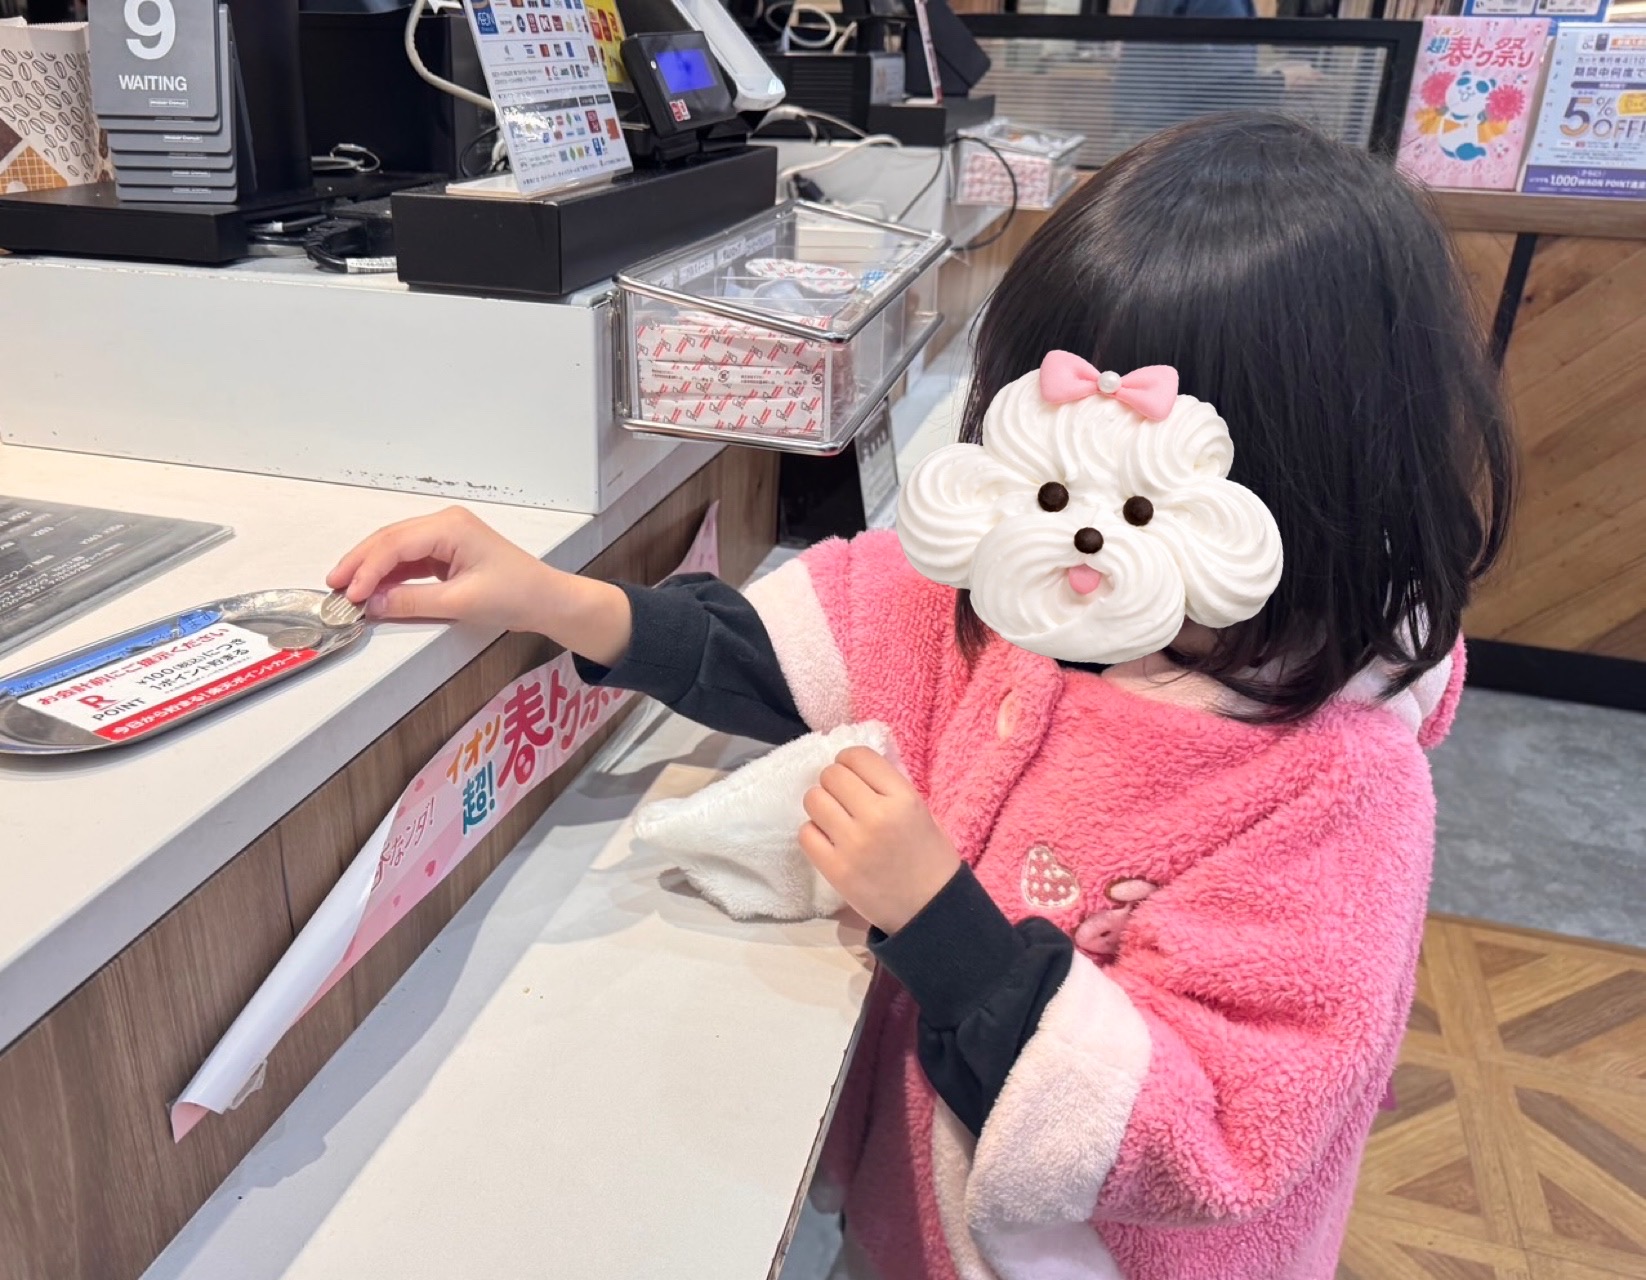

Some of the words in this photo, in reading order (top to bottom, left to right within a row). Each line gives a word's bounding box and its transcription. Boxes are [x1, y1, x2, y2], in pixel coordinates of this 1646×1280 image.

[122, 0, 177, 60] 9
[118, 74, 188, 91] WAITING
[77, 694, 116, 712] R
[92, 698, 147, 722] POINT
[445, 714, 501, 784] イオン
[462, 762, 496, 835] 超!
